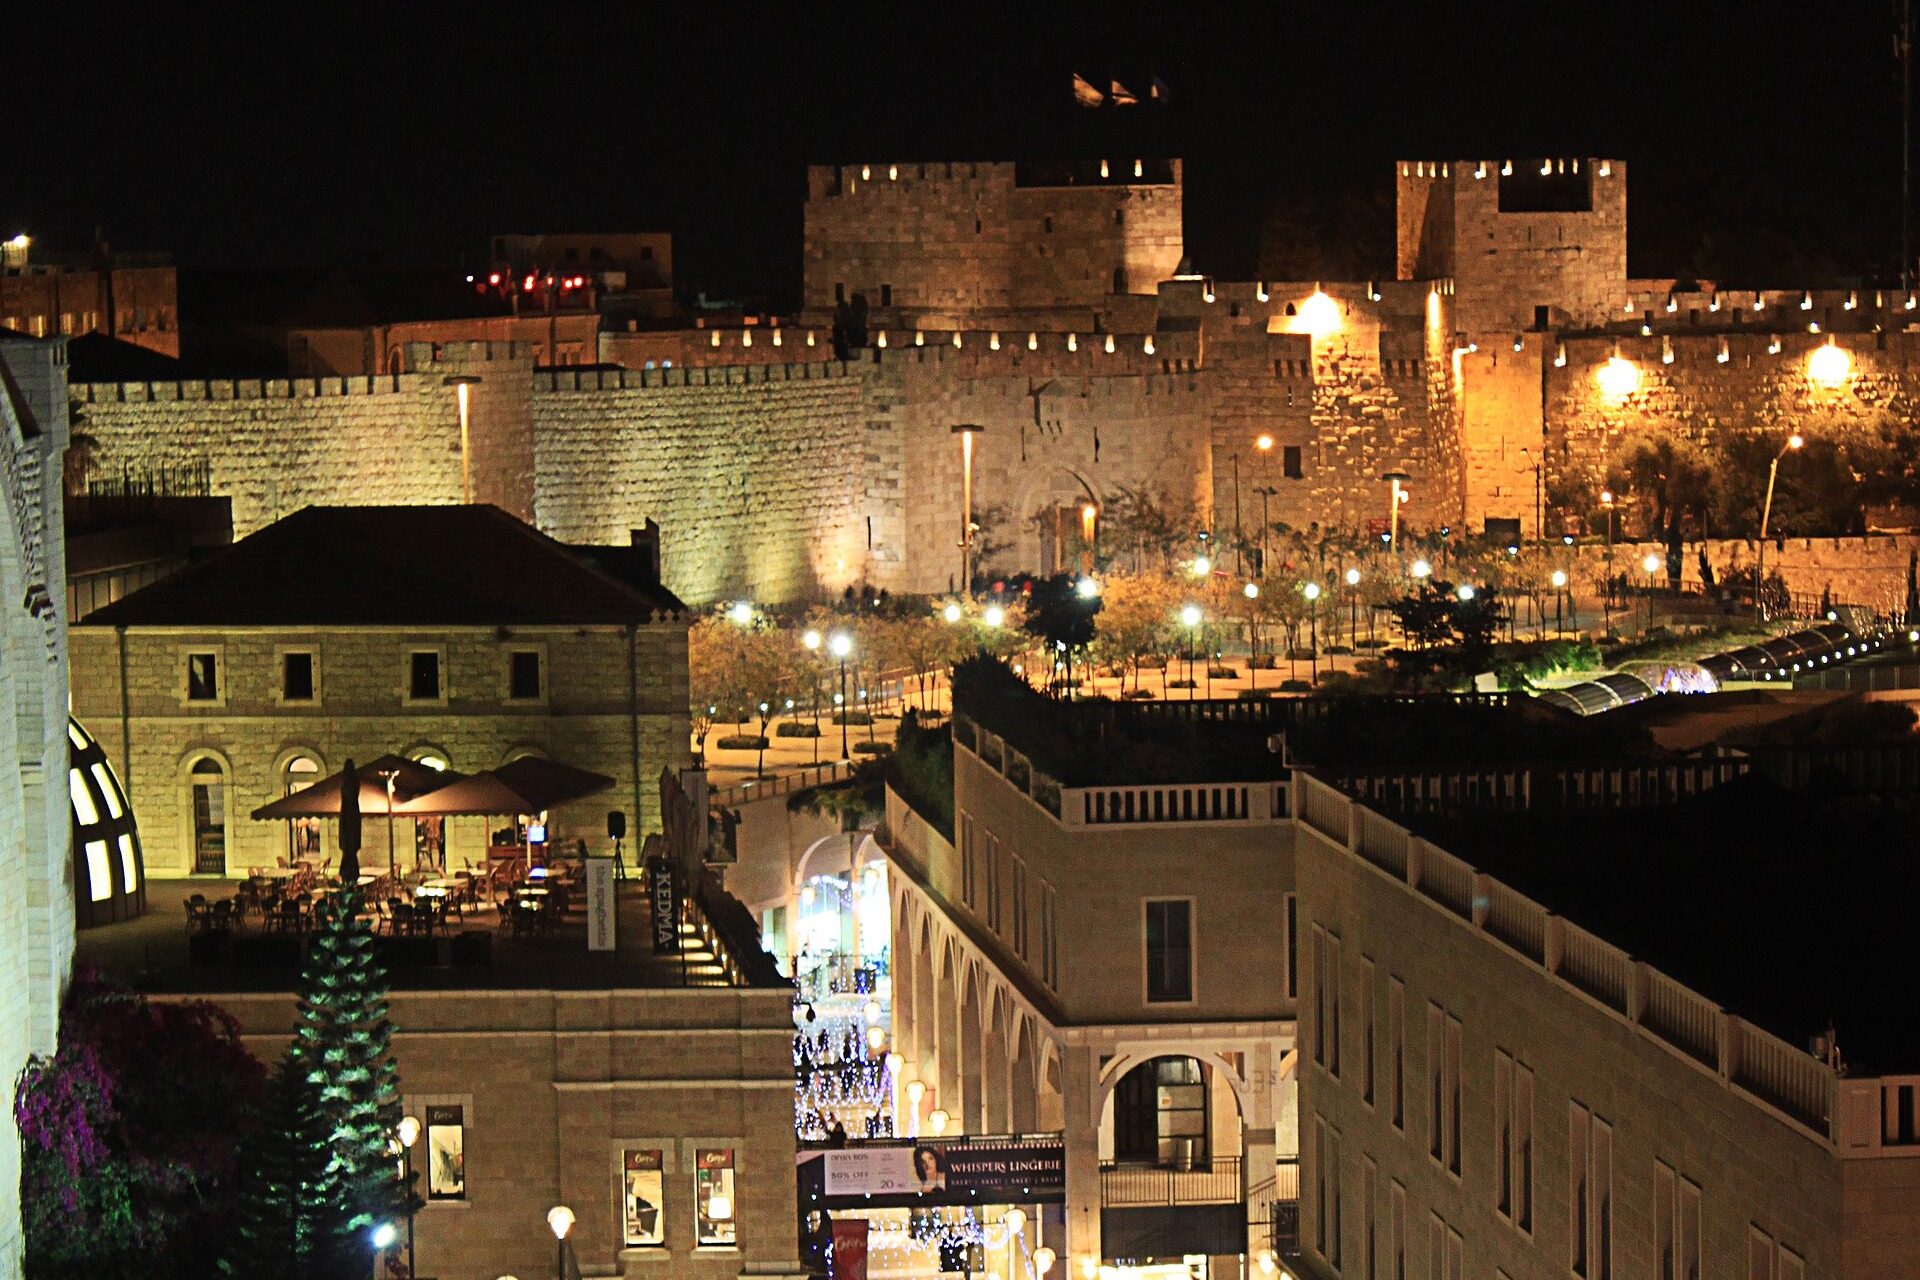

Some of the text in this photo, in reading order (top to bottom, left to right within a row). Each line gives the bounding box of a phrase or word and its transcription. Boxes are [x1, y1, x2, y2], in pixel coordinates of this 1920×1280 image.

[656, 872, 674, 944] KEDMA
[950, 1159, 1061, 1173] WHISPERS LINGERIE
[880, 1180, 894, 1190] 20
